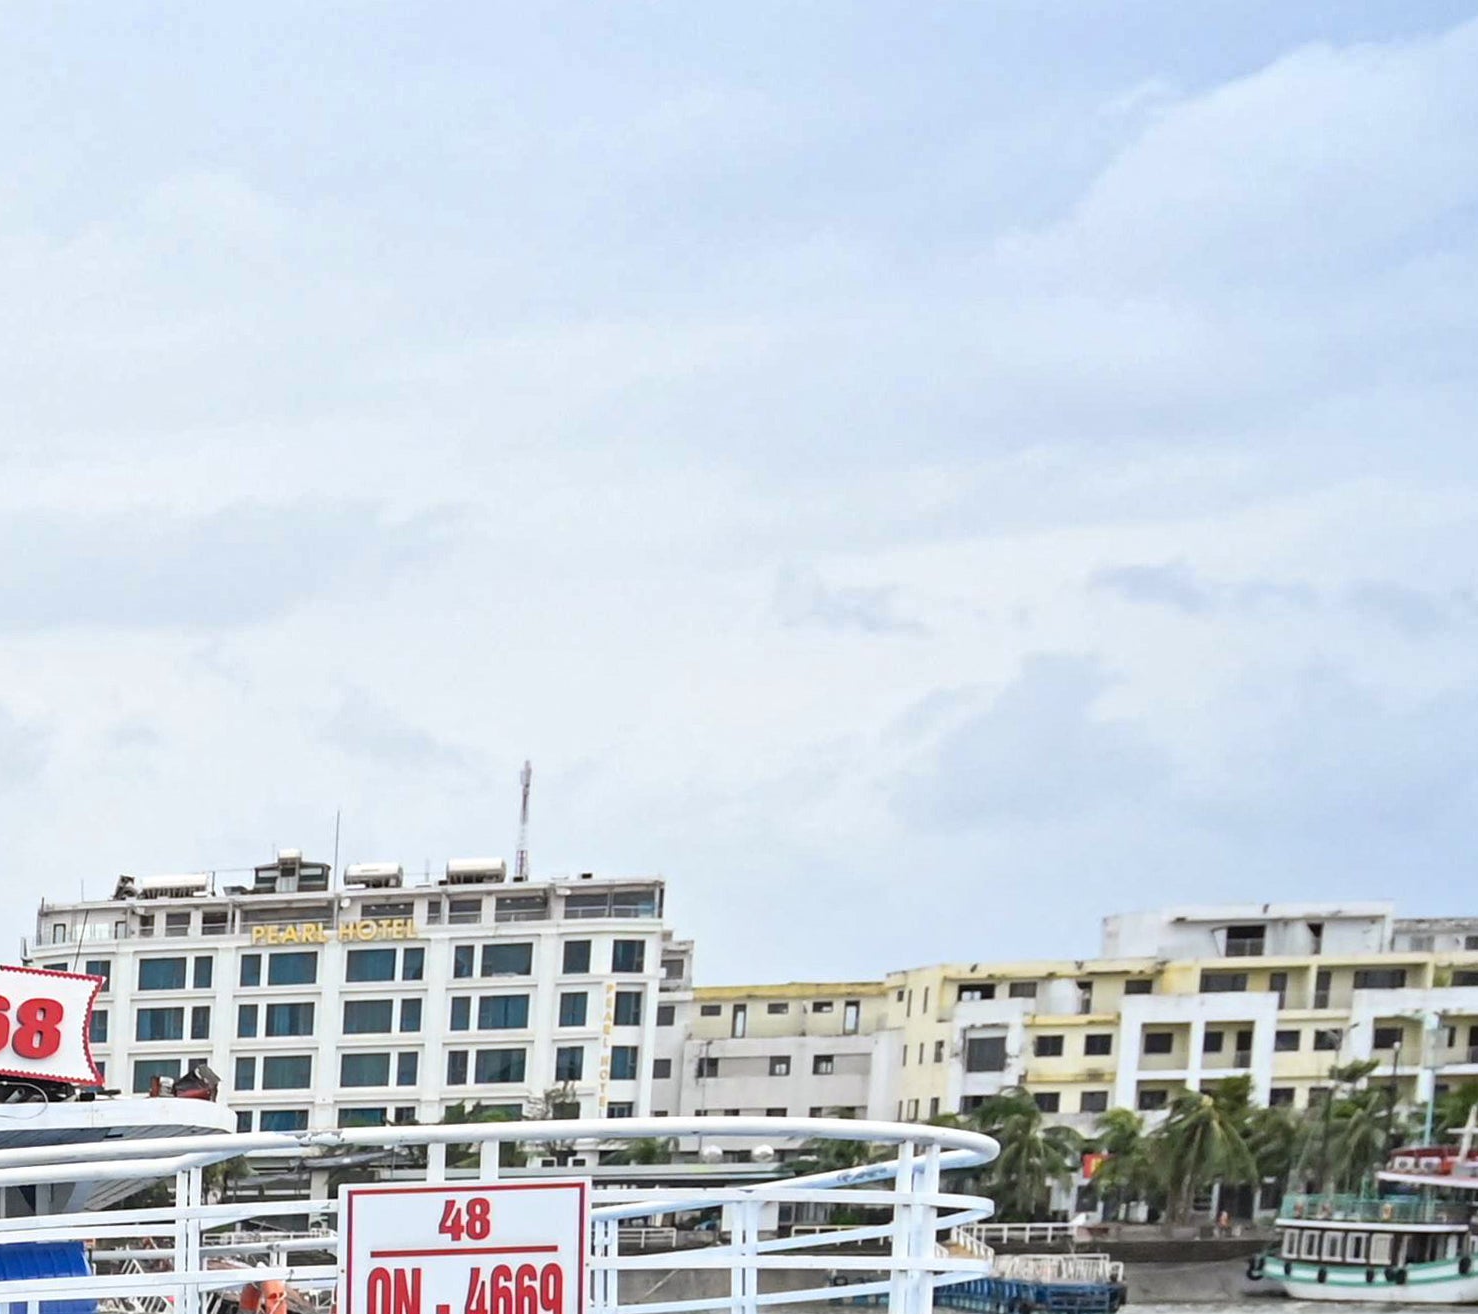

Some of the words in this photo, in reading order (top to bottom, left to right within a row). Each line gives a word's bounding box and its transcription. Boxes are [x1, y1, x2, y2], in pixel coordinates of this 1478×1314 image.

[251, 922, 328, 945] PEARL
[338, 919, 419, 942] HOTEL
[438, 1197, 491, 1241] 48
